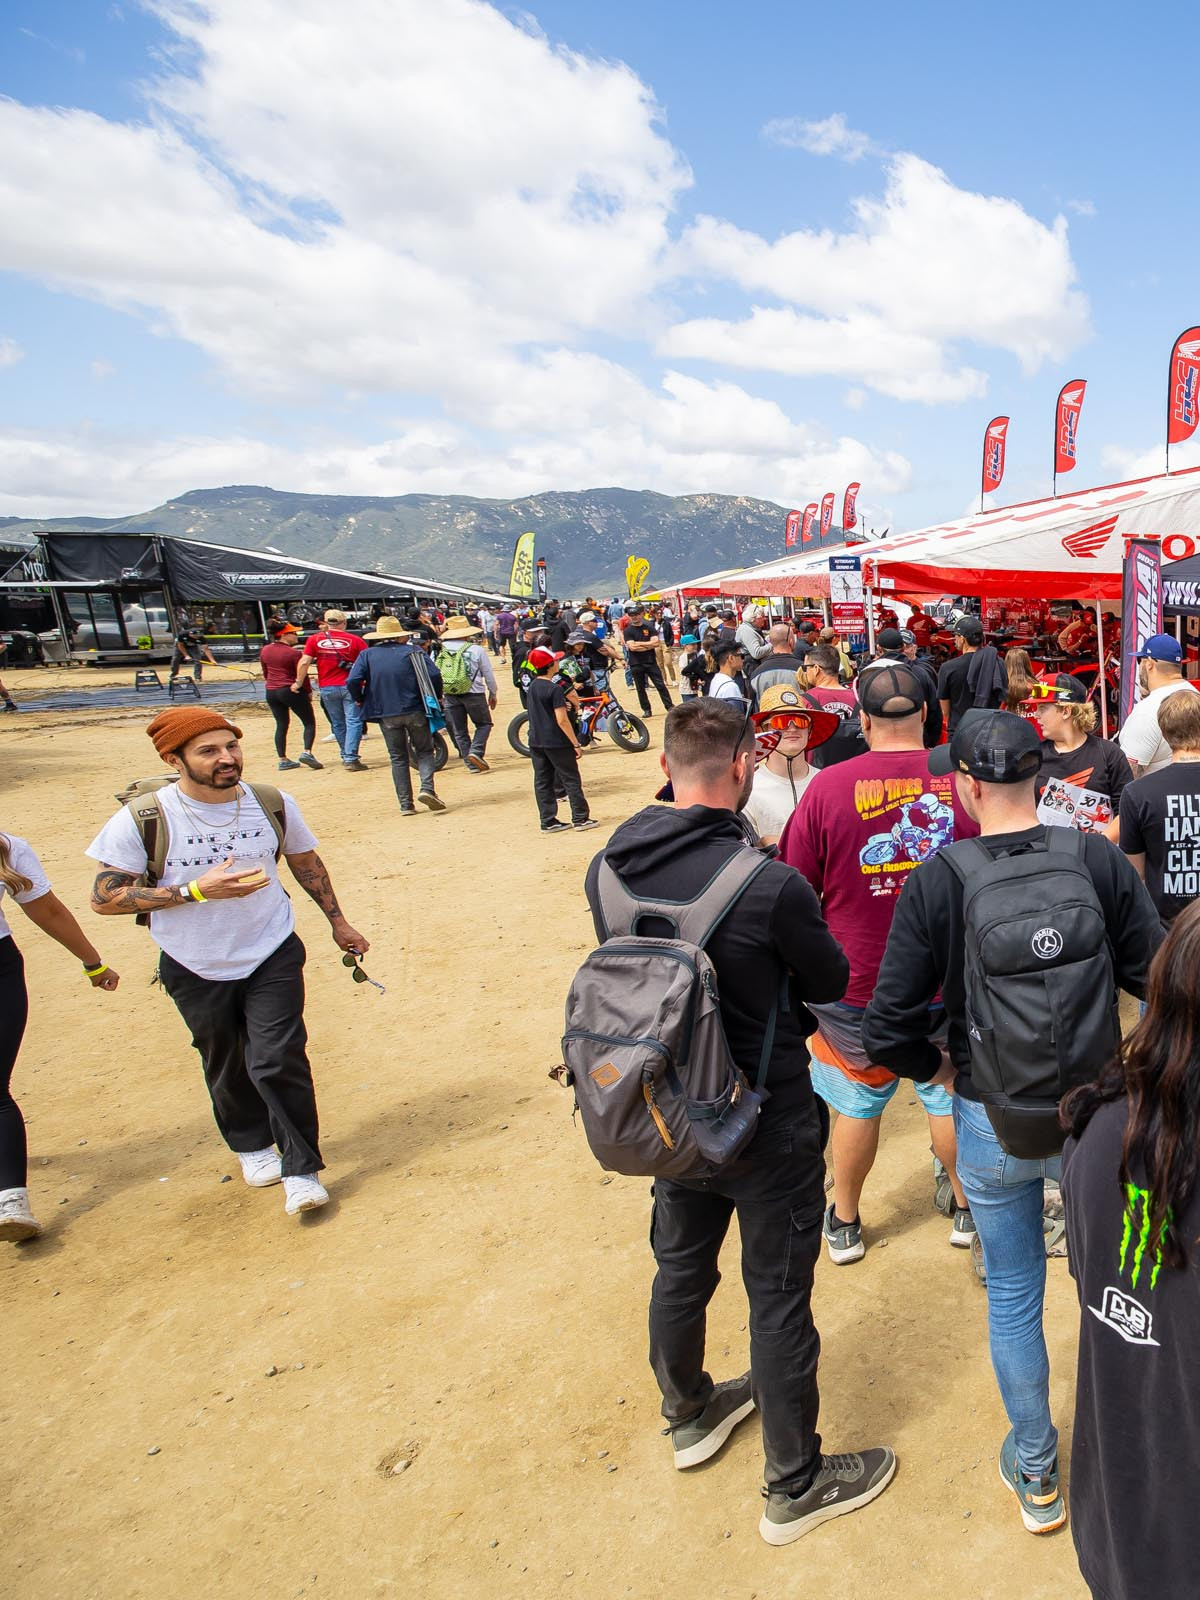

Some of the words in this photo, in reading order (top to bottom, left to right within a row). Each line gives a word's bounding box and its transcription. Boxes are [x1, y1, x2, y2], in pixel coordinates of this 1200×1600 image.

[184, 833, 222, 845] THE
[229, 827, 266, 841] REZ
[1110, 1293, 1146, 1331] DUB
